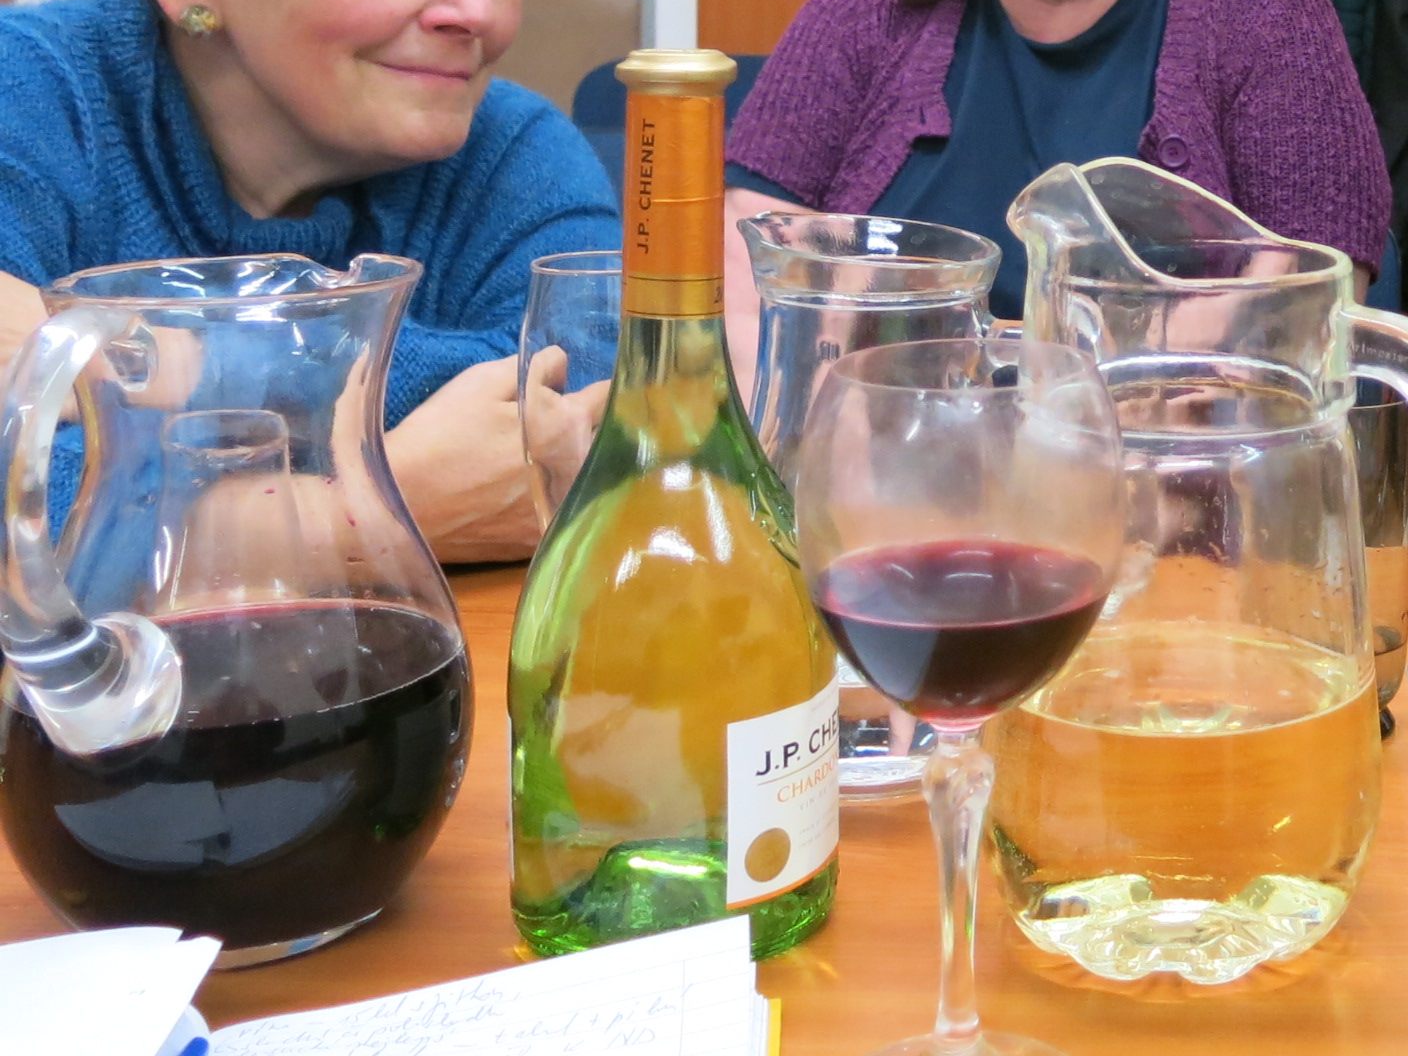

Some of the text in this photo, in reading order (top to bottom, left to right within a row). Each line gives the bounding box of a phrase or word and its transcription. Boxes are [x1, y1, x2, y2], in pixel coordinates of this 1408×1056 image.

[637, 119, 655, 254] J.P. CHENET
[755, 741, 801, 776] J.P.
